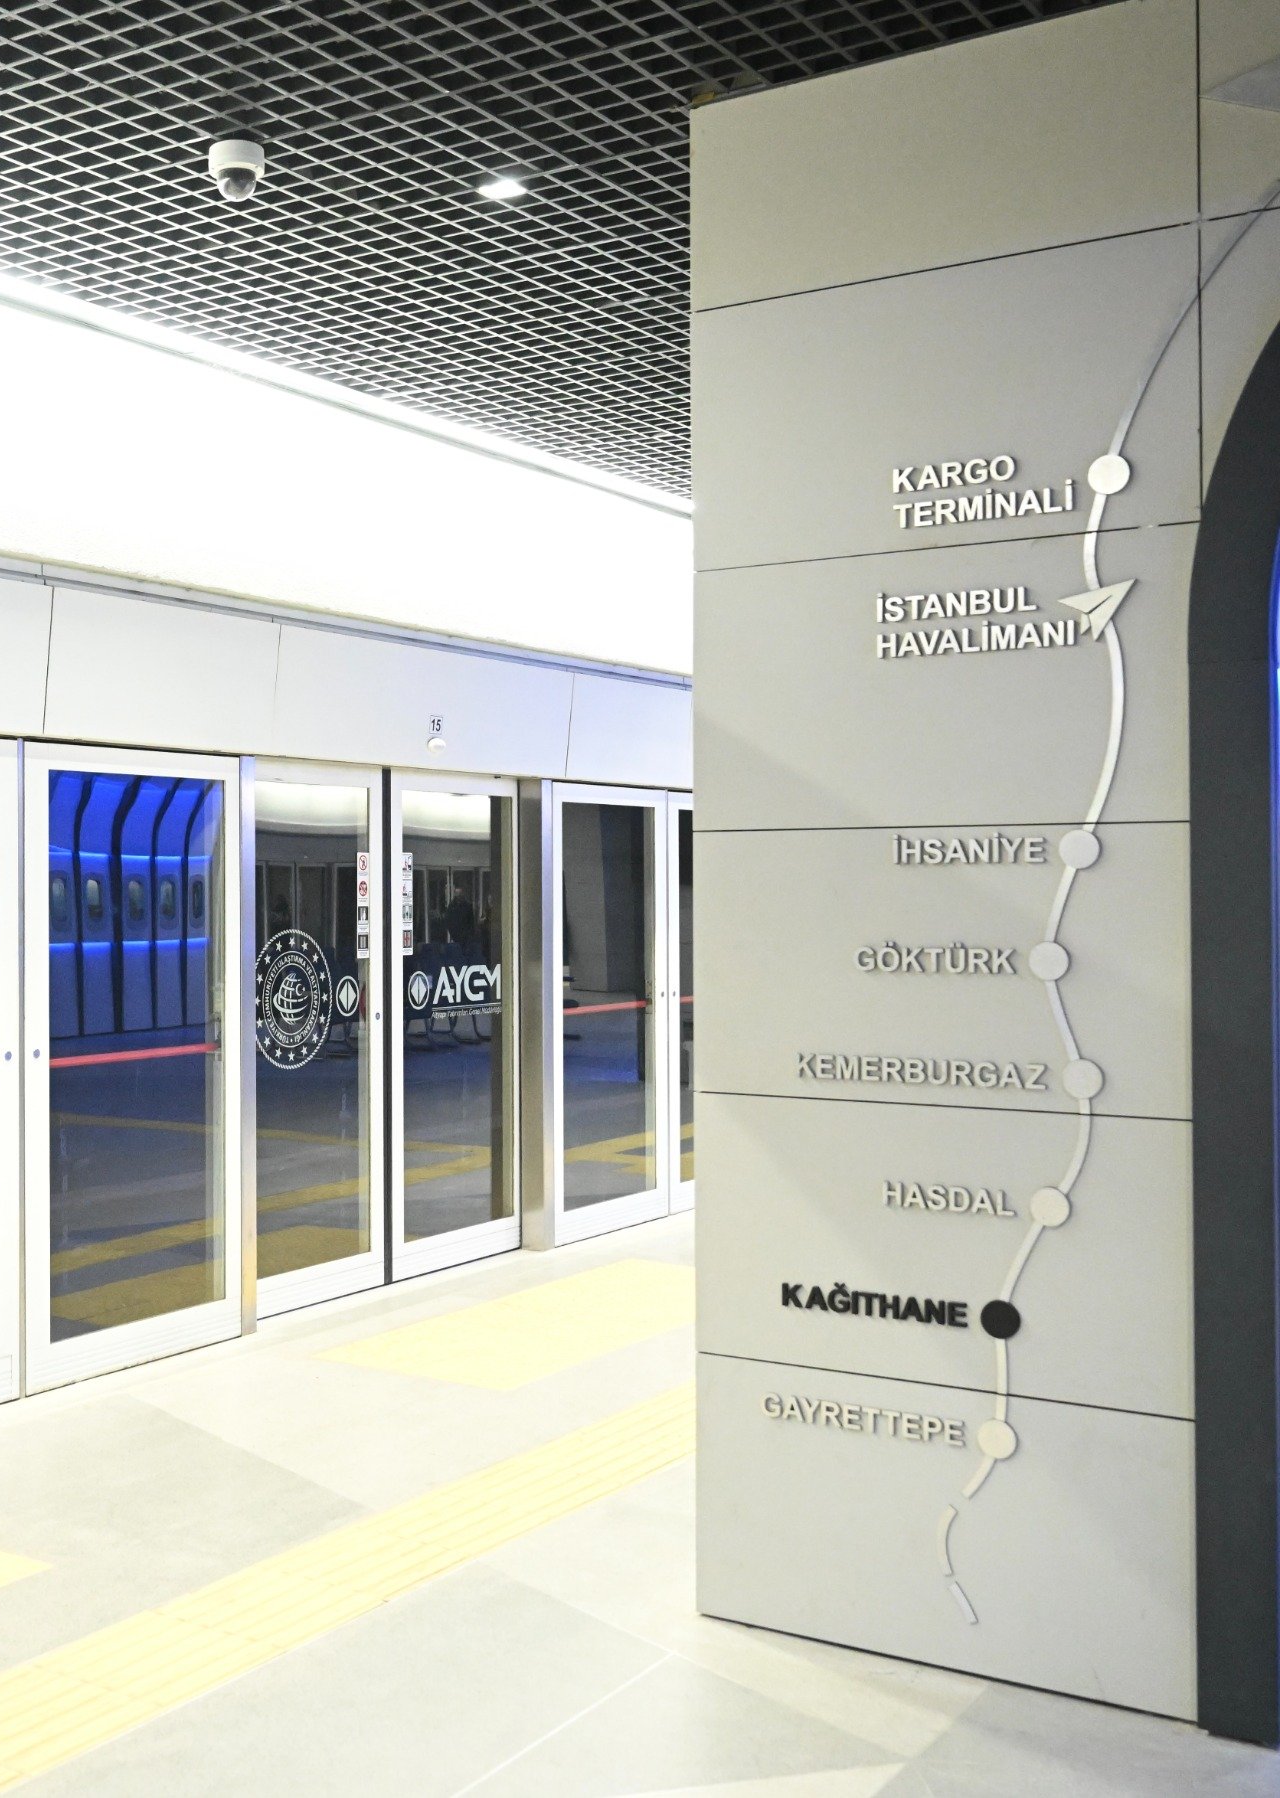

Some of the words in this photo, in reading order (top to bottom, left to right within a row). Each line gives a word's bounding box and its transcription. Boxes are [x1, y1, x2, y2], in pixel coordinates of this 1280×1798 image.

[892, 455, 1016, 494] KARGO
[893, 478, 1073, 529] TERMİNALİ
[876, 586, 1037, 623] İSTANBUL
[877, 619, 1075, 659] HAVALİMANI
[431, 718, 442, 732] 15
[892, 833, 1046, 865] İHSANİYE
[854, 942, 1016, 974] GÖKTÜRK
[432, 964, 501, 1005] AYGM
[796, 1052, 1048, 1091] KEMERBURGAZ
[882, 1181, 1015, 1216] HASDAL
[781, 1283, 968, 1328] KAĞITHANE
[760, 1393, 966, 1447] GAYRETTEPE
